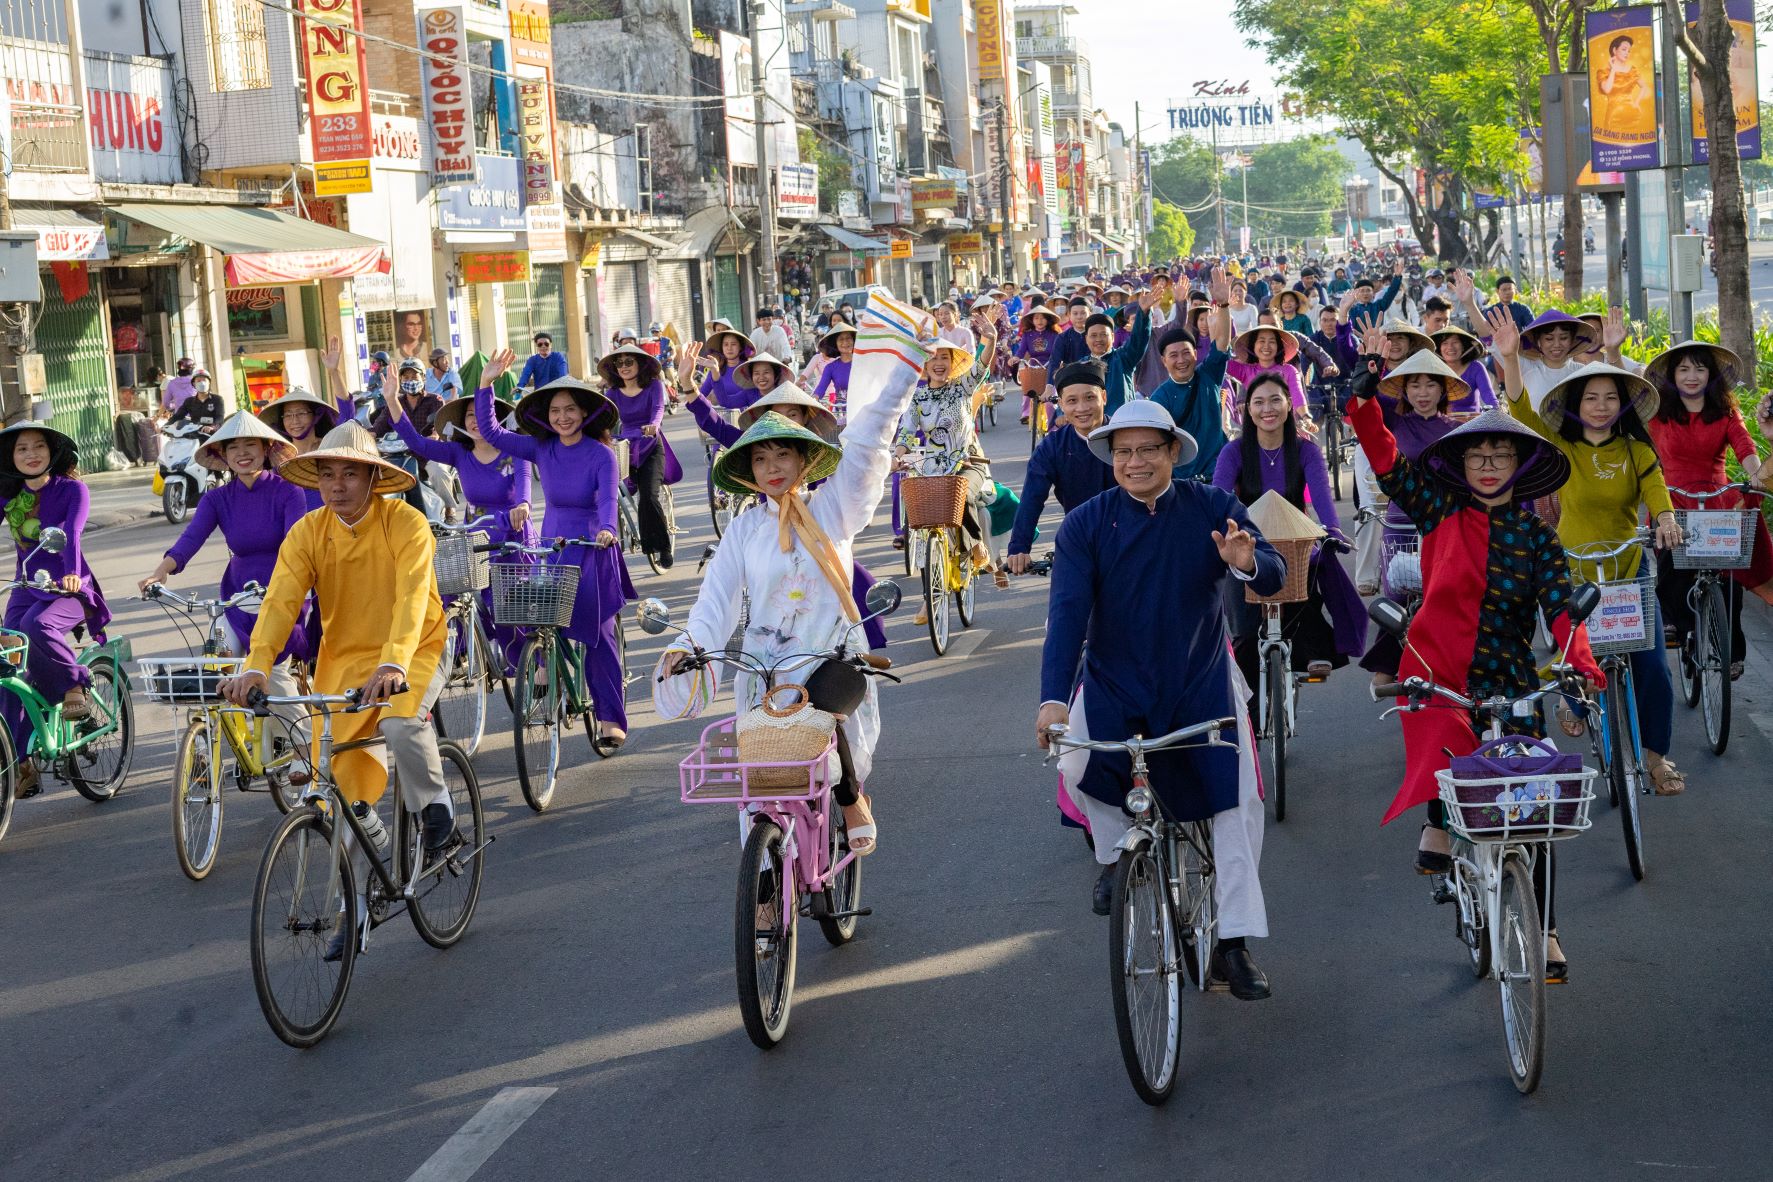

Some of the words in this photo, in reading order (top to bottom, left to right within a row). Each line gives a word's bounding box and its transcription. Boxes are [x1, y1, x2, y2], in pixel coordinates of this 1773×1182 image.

[1192, 79, 1250, 96] Kính
[1167, 102, 1233, 129] TRƯỜNG
[1237, 97, 1273, 126] TIỀN
[321, 115, 357, 132] 233
